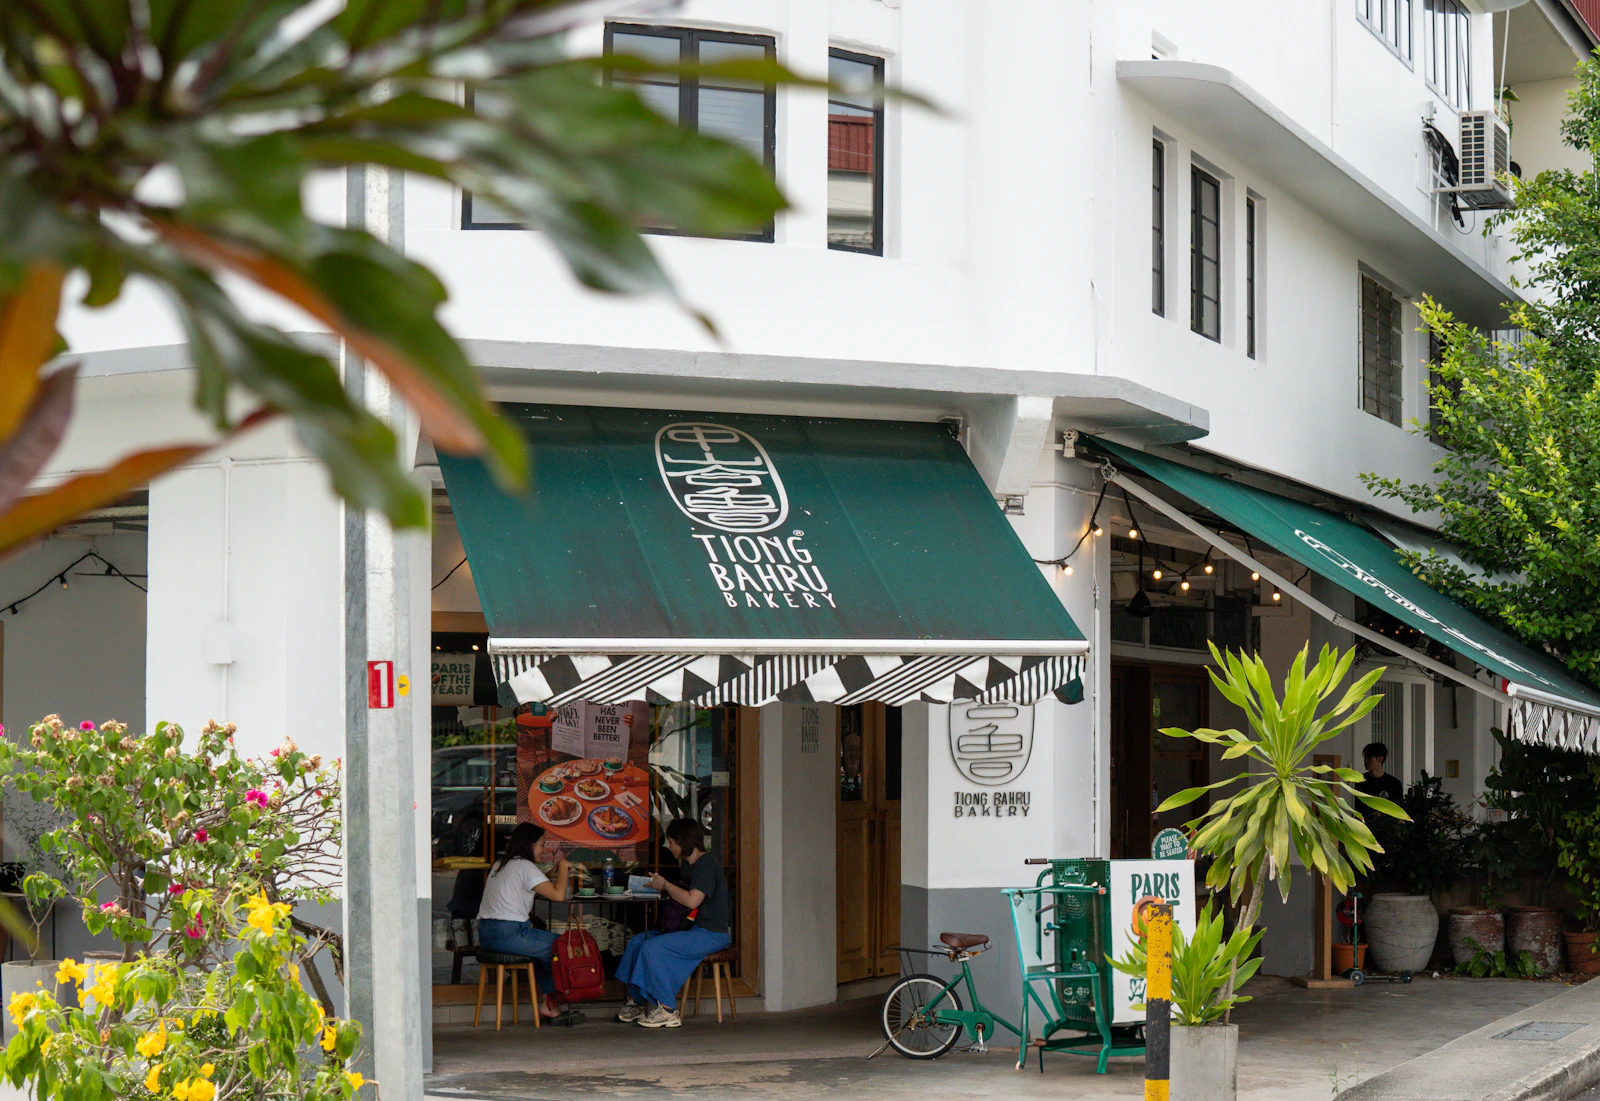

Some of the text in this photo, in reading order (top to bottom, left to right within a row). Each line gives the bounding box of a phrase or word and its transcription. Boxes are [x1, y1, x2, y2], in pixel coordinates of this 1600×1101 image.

[692, 534, 813, 564] TIONG
[709, 563, 828, 592] BAHRU
[723, 592, 837, 608] BAKERY
[431, 663, 471, 674] PARIS
[374, 662, 388, 707] 1
[449, 675, 471, 685] THE
[431, 685, 471, 695] YEAST
[600, 707, 616, 716] HAS
[595, 716, 620, 725] NEVER
[597, 725, 617, 733] BEEN
[593, 733, 620, 742] BETTER!
[954, 791, 1031, 806] TIONG BAHRU
[954, 805, 1030, 818] BAKERY
[1161, 834, 1178, 844] PLEASE
[1160, 842, 1172, 851] WAIT
[1159, 850, 1166, 858] BE
[1166, 847, 1183, 857] SEATED
[1131, 872, 1180, 905] PARIS
